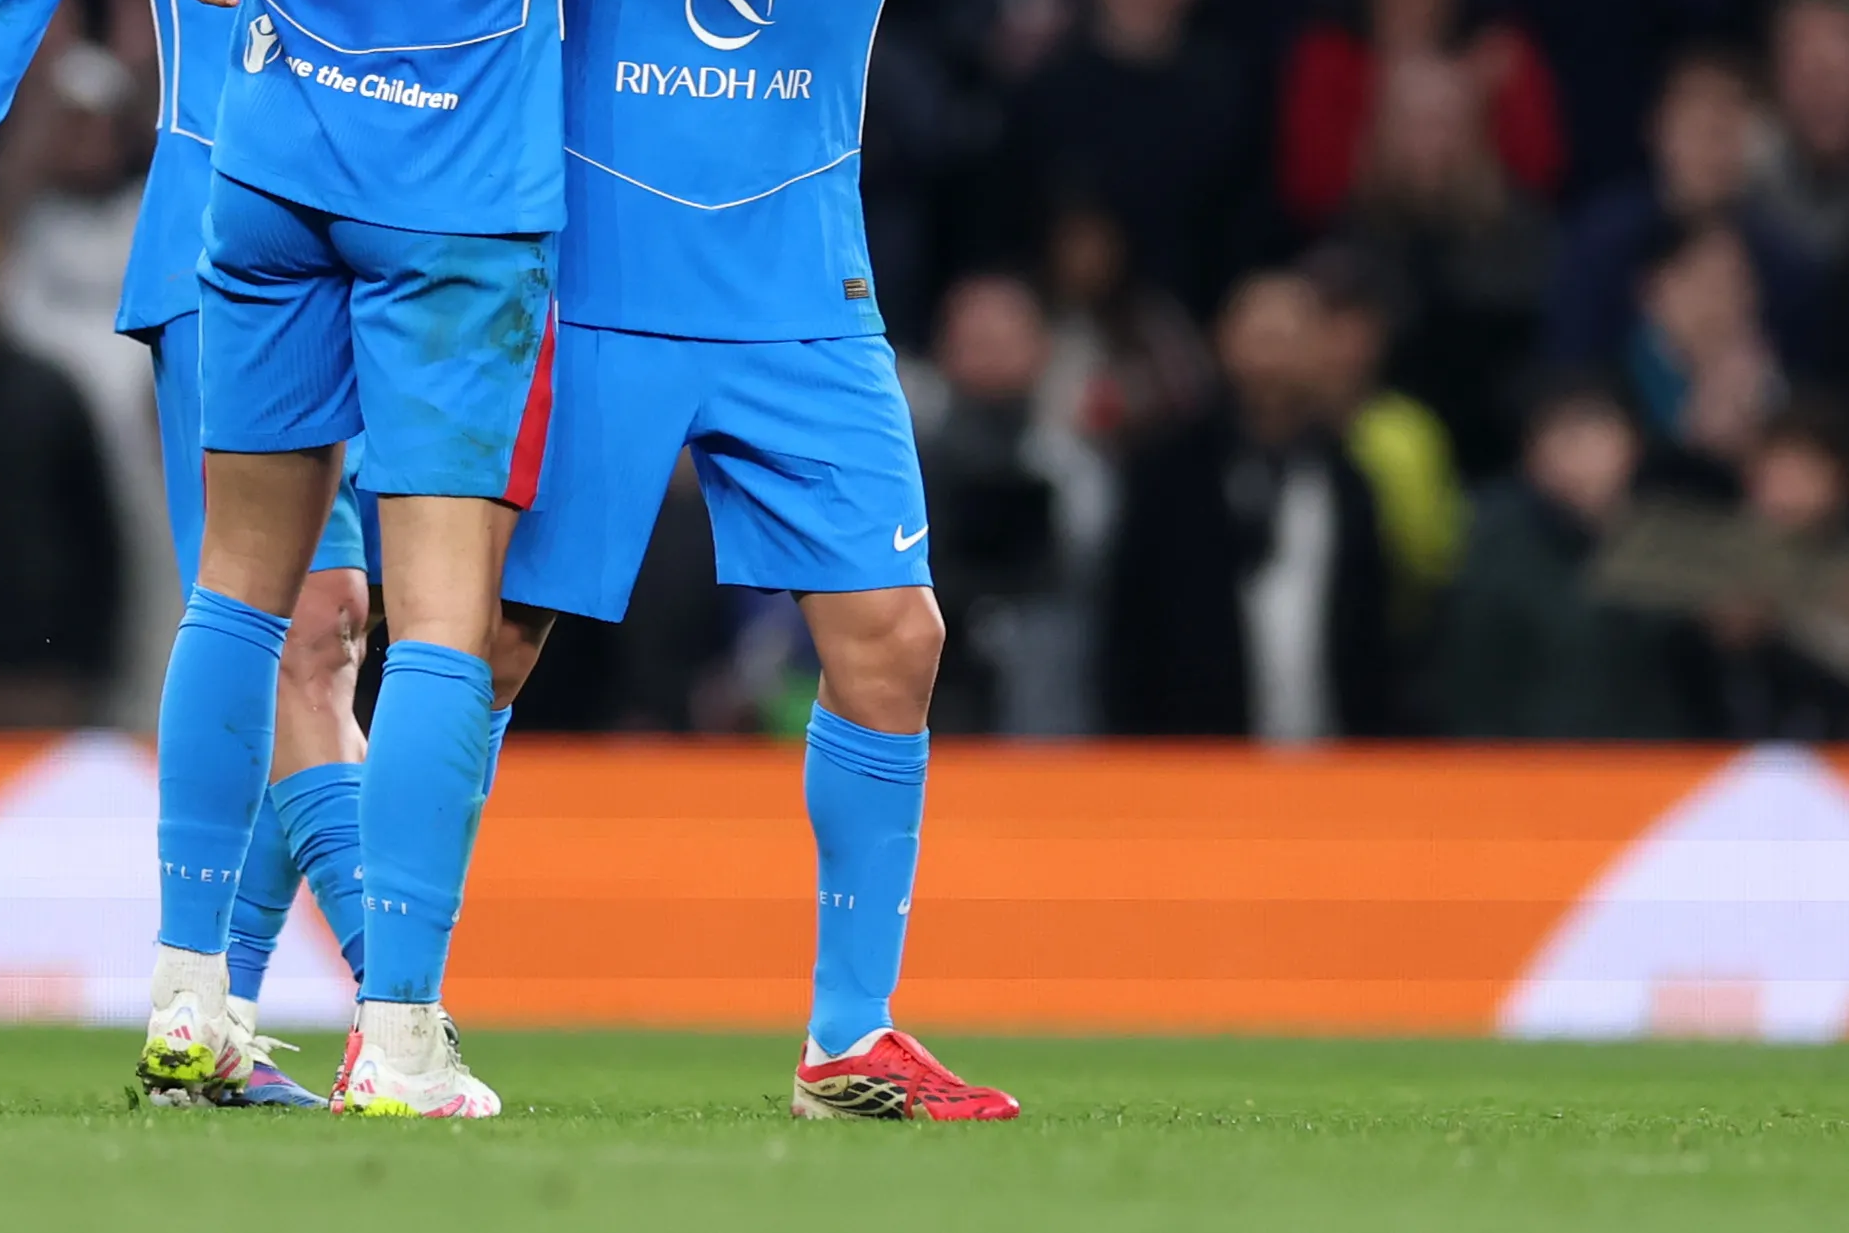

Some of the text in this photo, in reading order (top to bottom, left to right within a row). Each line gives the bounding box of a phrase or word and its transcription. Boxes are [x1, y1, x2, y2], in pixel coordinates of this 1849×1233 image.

[316, 65, 358, 93] the
[360, 74, 459, 110] Children
[615, 60, 812, 99] RIYADH AIR
[160, 862, 239, 883] TLETI
